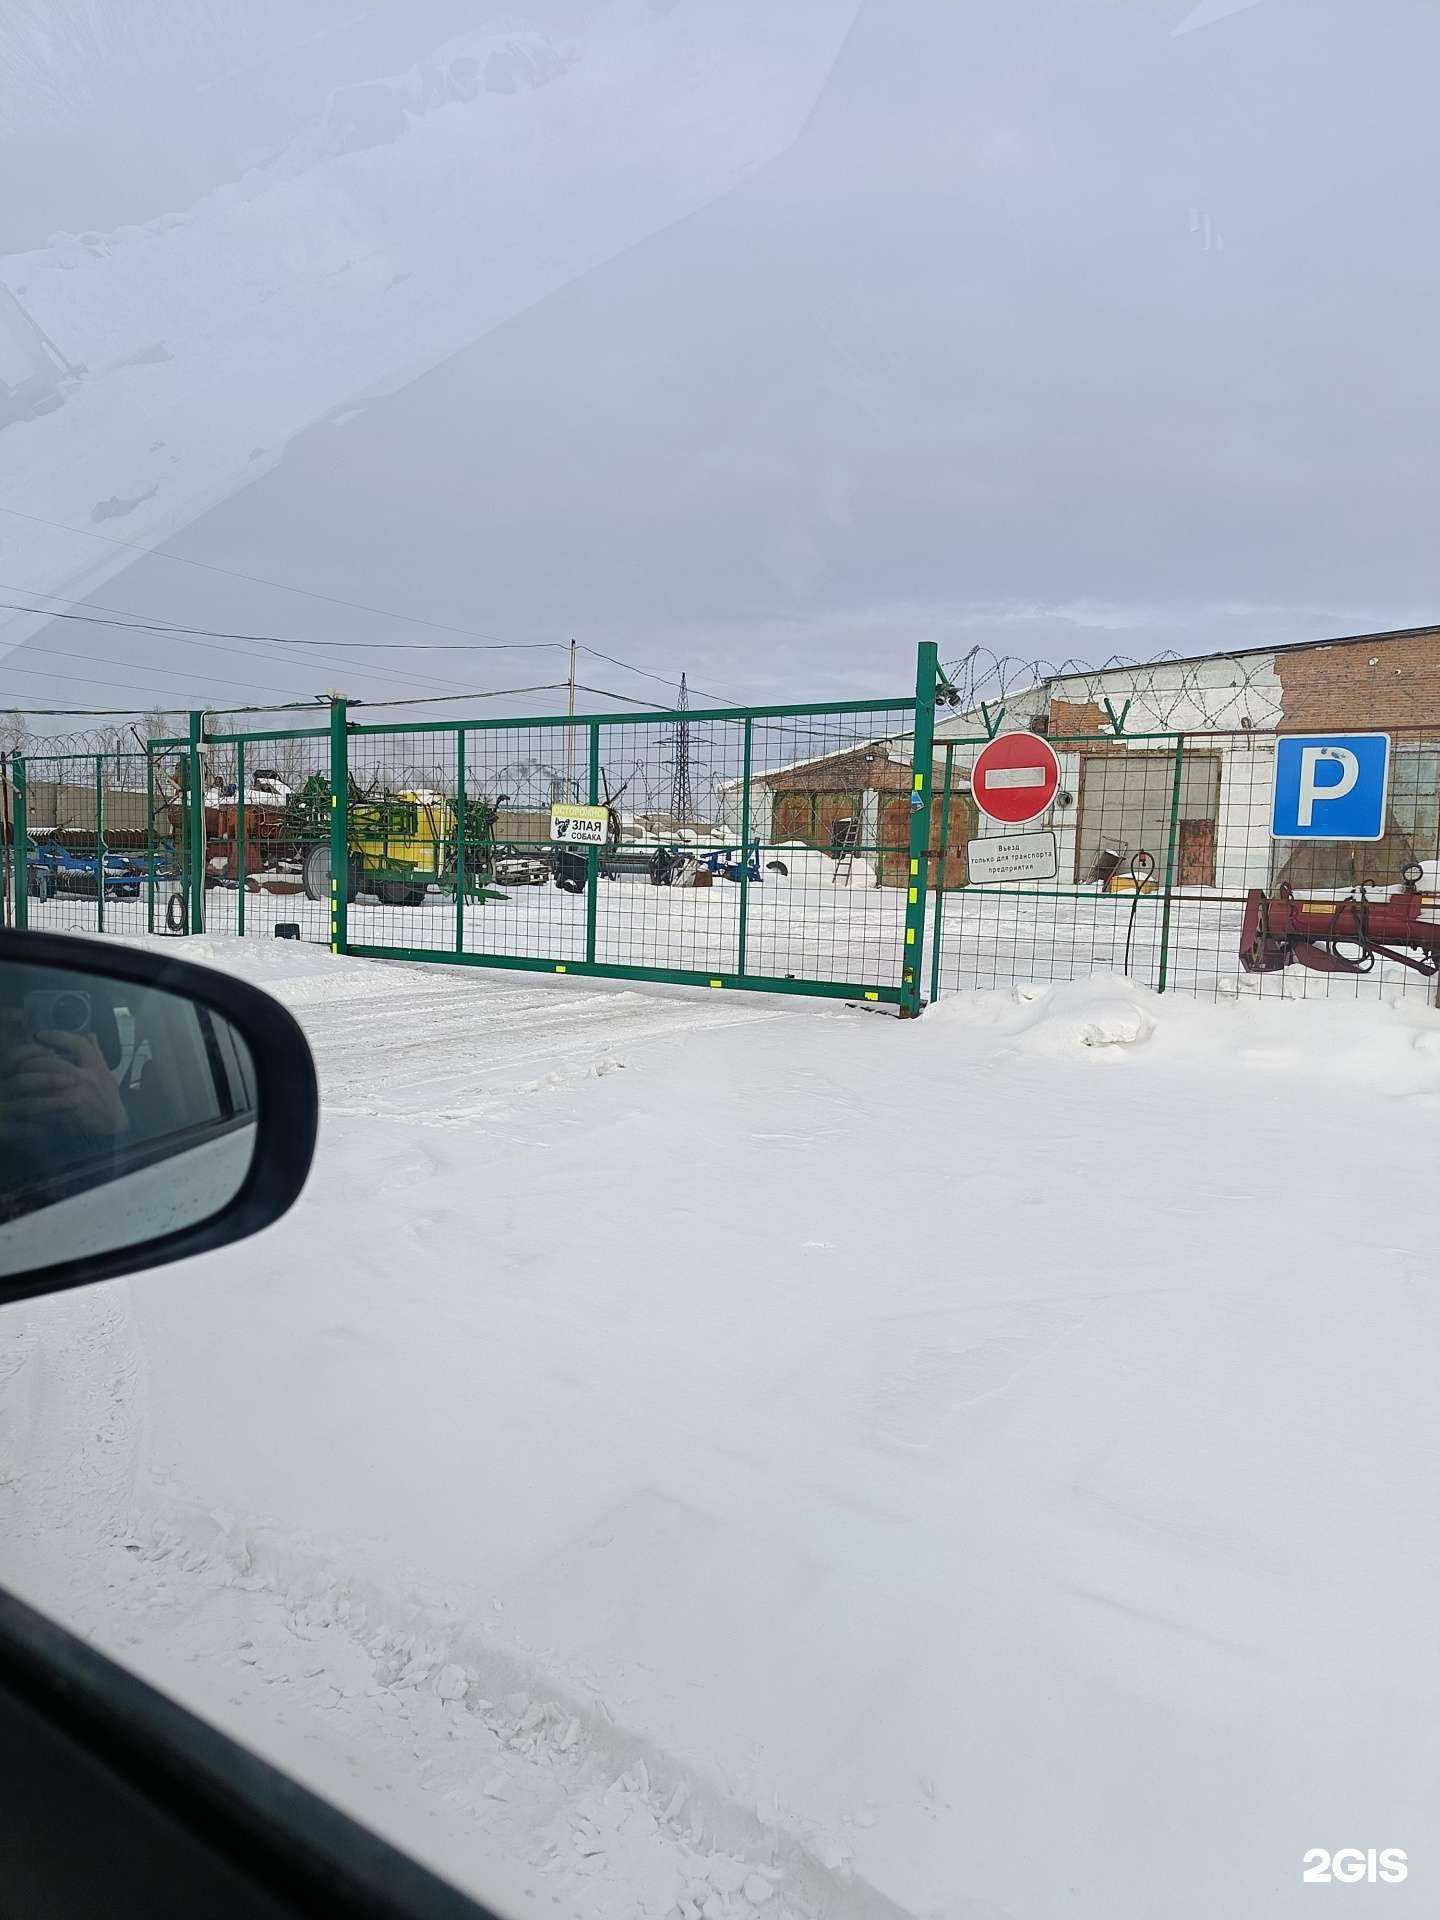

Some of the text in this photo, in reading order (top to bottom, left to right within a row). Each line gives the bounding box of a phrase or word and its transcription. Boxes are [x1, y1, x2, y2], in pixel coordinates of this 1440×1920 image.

[1297, 747, 1359, 827] P
[572, 820, 602, 831] ЗЛАЯ
[571, 832, 602, 841] СОБАКА
[1011, 851, 1052, 861] транспорта
